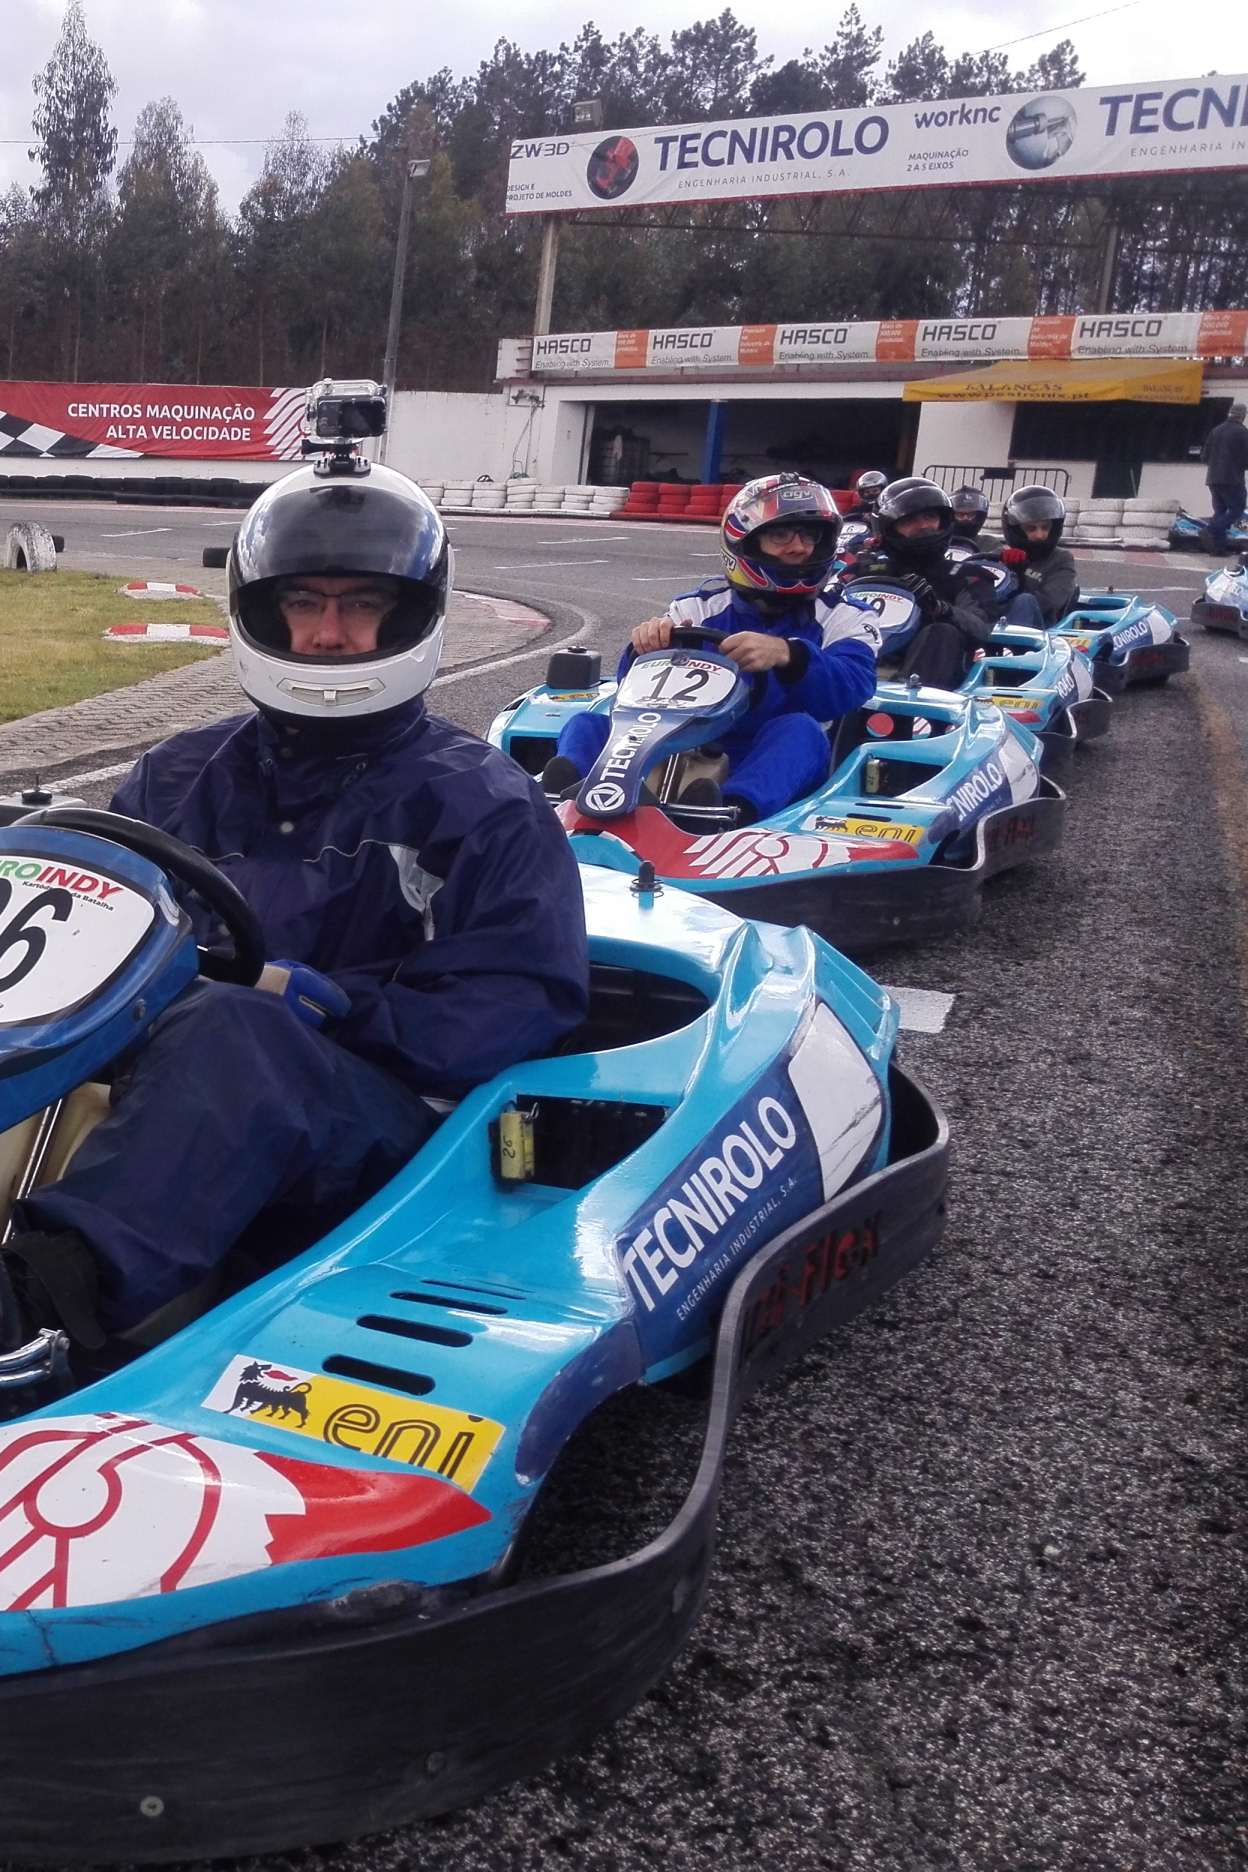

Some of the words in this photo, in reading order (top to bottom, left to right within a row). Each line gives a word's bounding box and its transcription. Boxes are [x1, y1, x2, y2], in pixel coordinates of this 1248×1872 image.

[511, 142, 570, 159] ZW3D
[654, 115, 890, 171] TECNIROLO
[1131, 141, 1223, 157] ENGENHARIA
[678, 175, 747, 189] ENGENHARIA
[780, 328, 848, 345] HASCO
[922, 325, 997, 342] HASCO
[1079, 320, 1163, 338] HASCO
[537, 339, 592, 355] HASCO
[653, 333, 713, 350] HASCO
[68, 404, 142, 418] CENTROS
[146, 404, 255, 423] MAQUINAÇÃO
[106, 425, 148, 439] ALTA
[152, 426, 251, 441] VELOCIDADE
[641, 660, 722, 671] EURNDY
[651, 667, 709, 701] 12
[855, 824, 917, 844] eni
[622, 1096, 797, 1312] TECNIROLO
[676, 1253, 731, 1321] ENGENHARIA
[323, 1403, 484, 1480] eni
